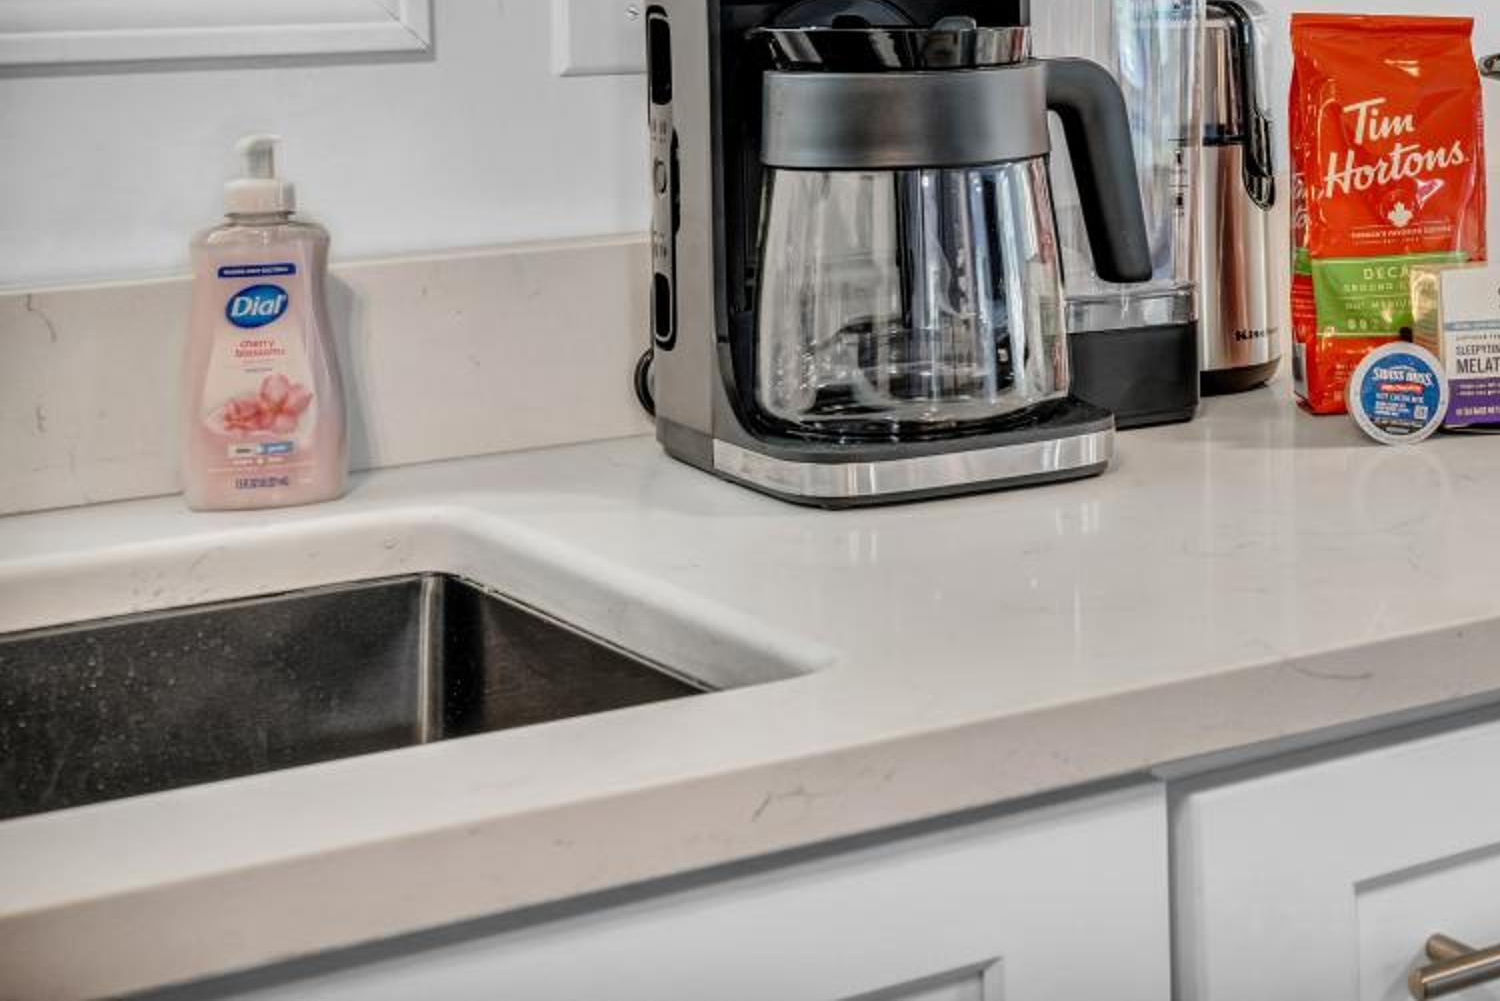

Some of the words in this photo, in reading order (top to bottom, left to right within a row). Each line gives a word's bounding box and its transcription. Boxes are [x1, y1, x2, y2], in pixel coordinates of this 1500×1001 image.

[1343, 97, 1415, 144] Tim
[1323, 139, 1467, 200] Hortons
[1362, 262, 1411, 281] DECA
[230, 293, 287, 319] Dial
